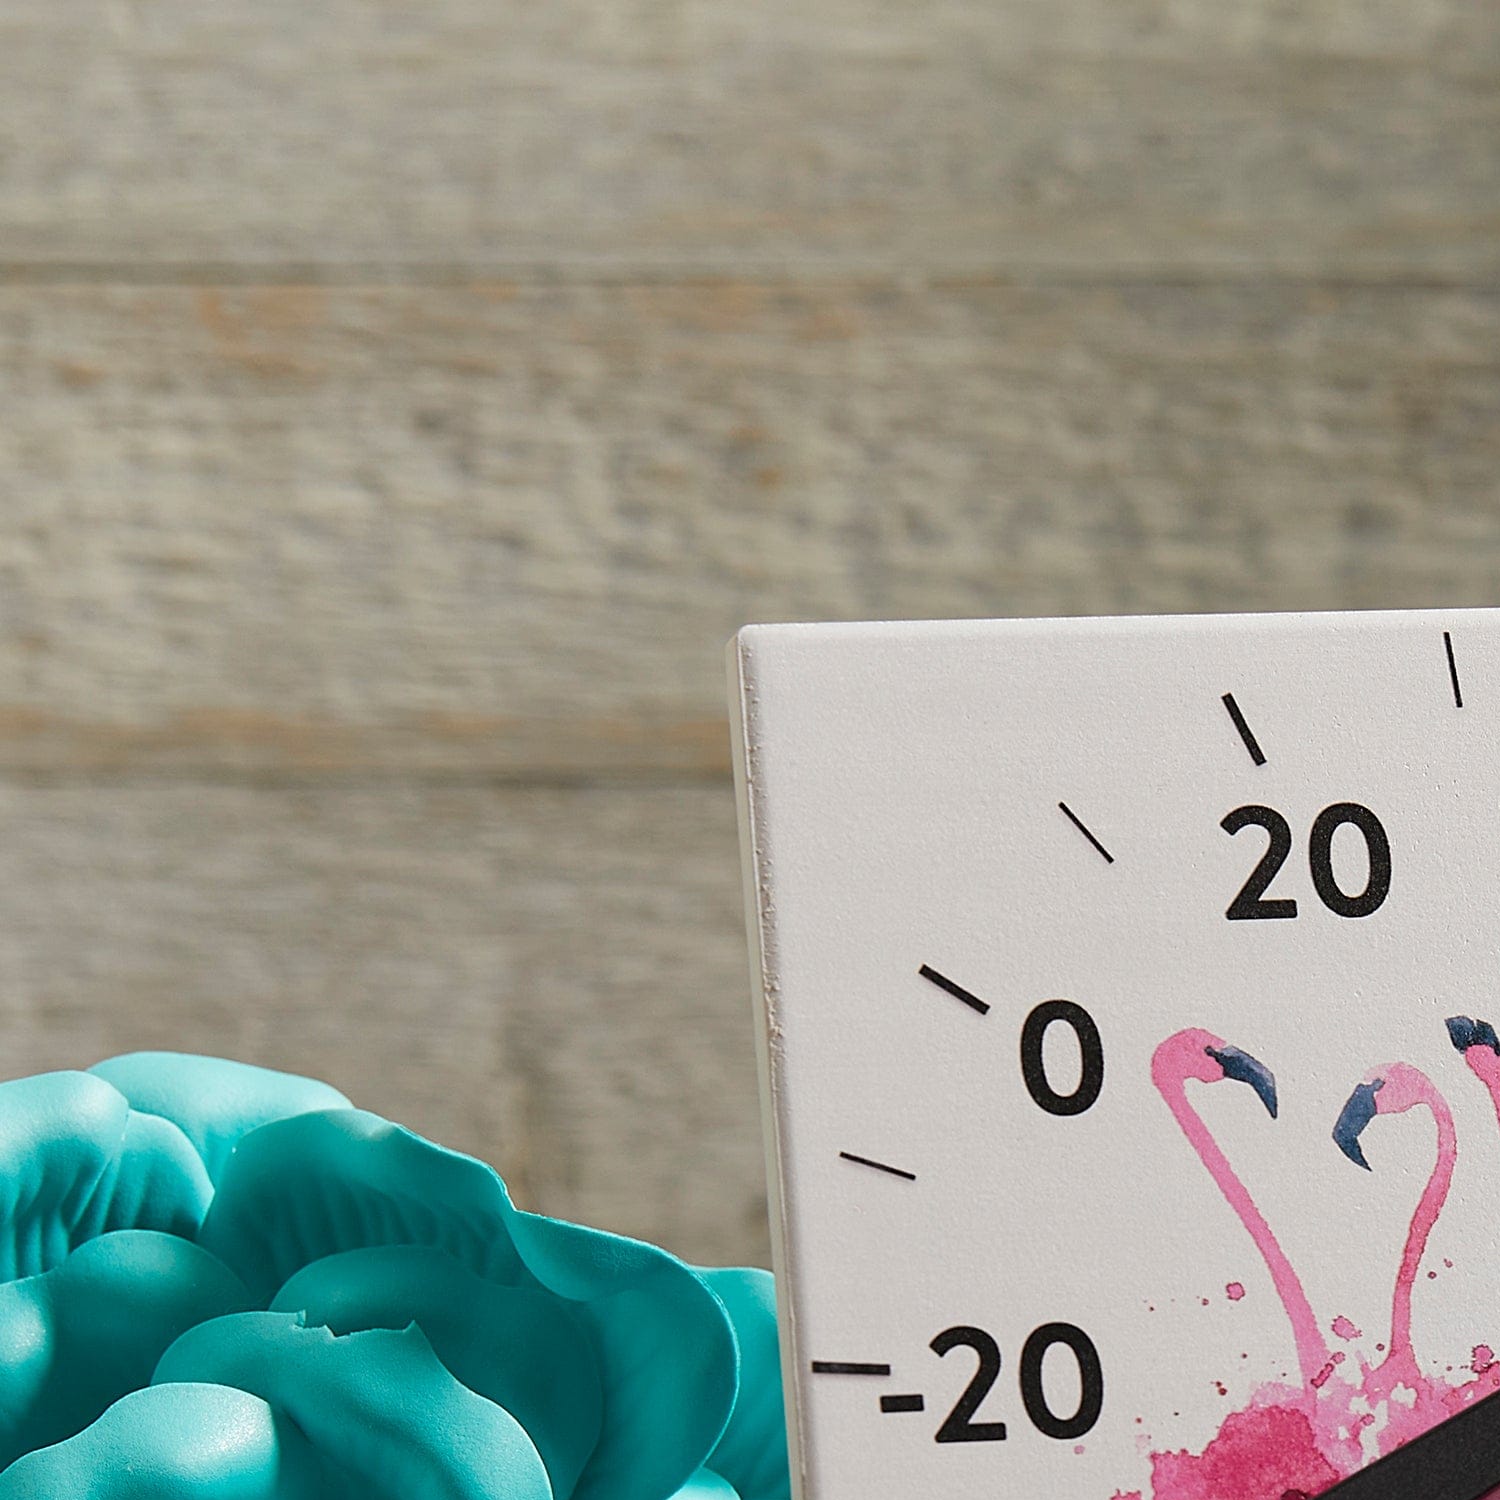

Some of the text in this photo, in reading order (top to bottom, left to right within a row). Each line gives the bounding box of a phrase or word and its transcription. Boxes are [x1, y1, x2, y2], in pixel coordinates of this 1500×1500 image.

[1220, 802, 1392, 921] 20
[1020, 999, 1105, 1117] 0
[879, 1322, 1104, 1444] -20
